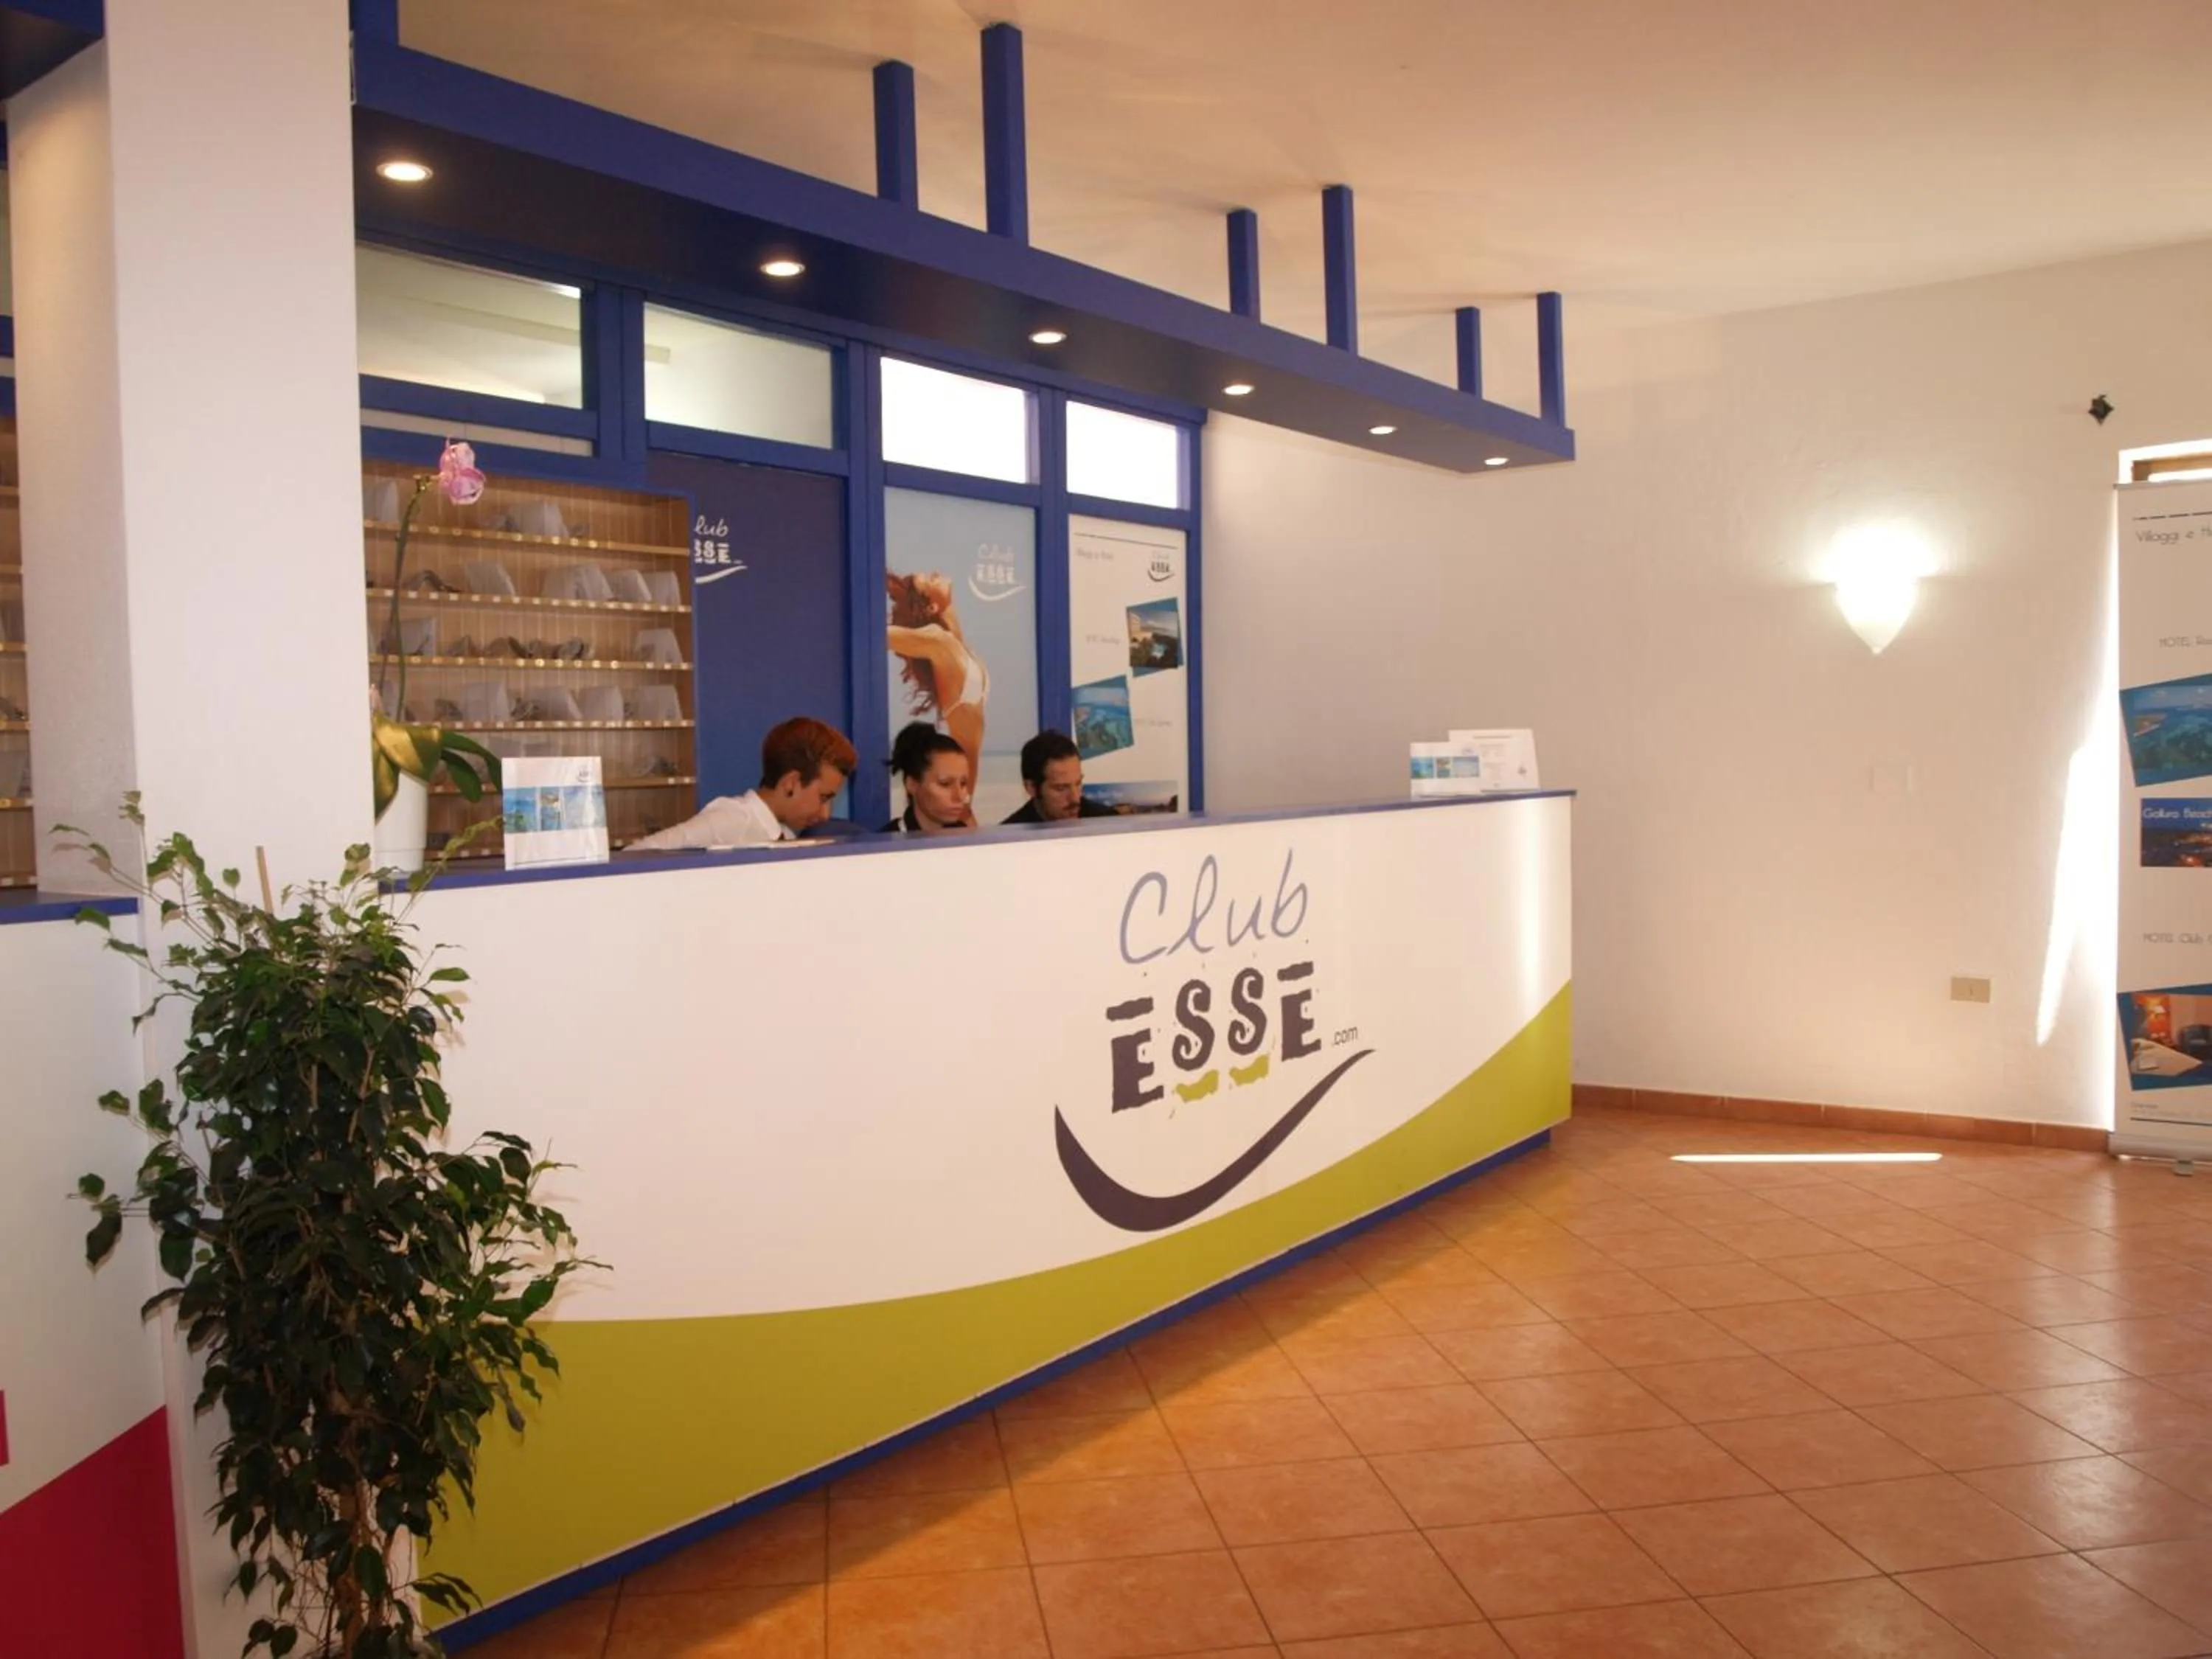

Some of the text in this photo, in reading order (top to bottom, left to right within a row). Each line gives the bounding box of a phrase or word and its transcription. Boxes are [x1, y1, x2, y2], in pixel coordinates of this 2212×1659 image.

[695, 515, 728, 537] lub
[695, 539, 731, 564] SSE
[1119, 847, 1308, 964] Club
[1105, 961, 1321, 1114] ESSE
